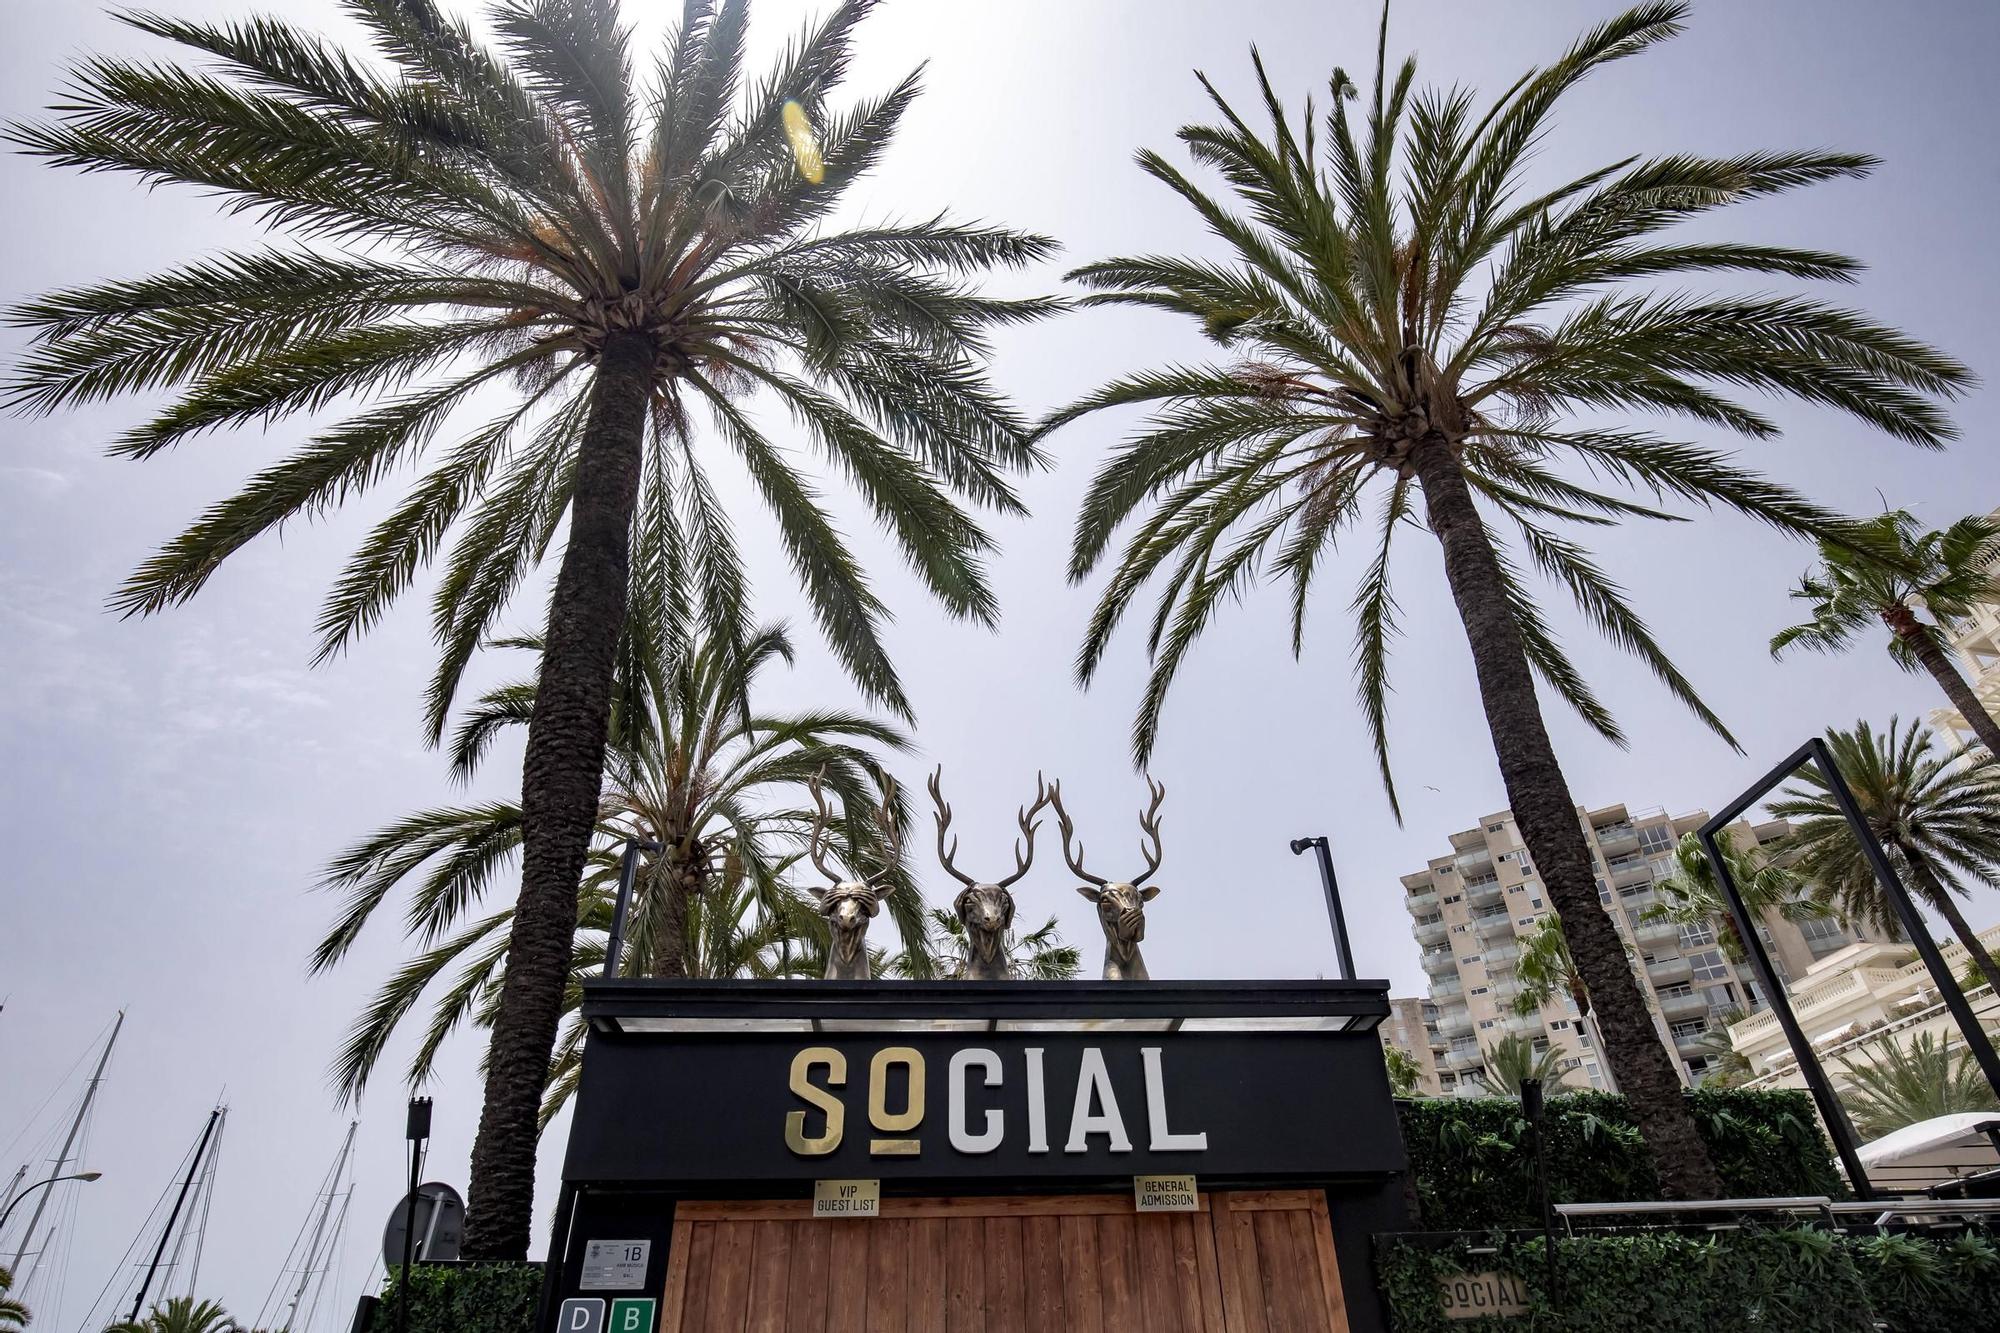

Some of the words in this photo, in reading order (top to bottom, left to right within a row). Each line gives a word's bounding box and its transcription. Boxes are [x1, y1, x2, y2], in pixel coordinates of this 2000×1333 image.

[785, 1046, 1208, 1156] SOCIAL
[839, 1185, 858, 1198] VIP
[1144, 1180, 1191, 1192] GENERAL
[817, 1199, 850, 1211] GUEST
[853, 1199, 876, 1211] LIST
[1140, 1194, 1194, 1206] ADMISSION
[624, 1246, 642, 1261] 1B
[1440, 1279, 1529, 1308] SOCIAL
[570, 1307, 590, 1330] D
[623, 1307, 640, 1331] B
